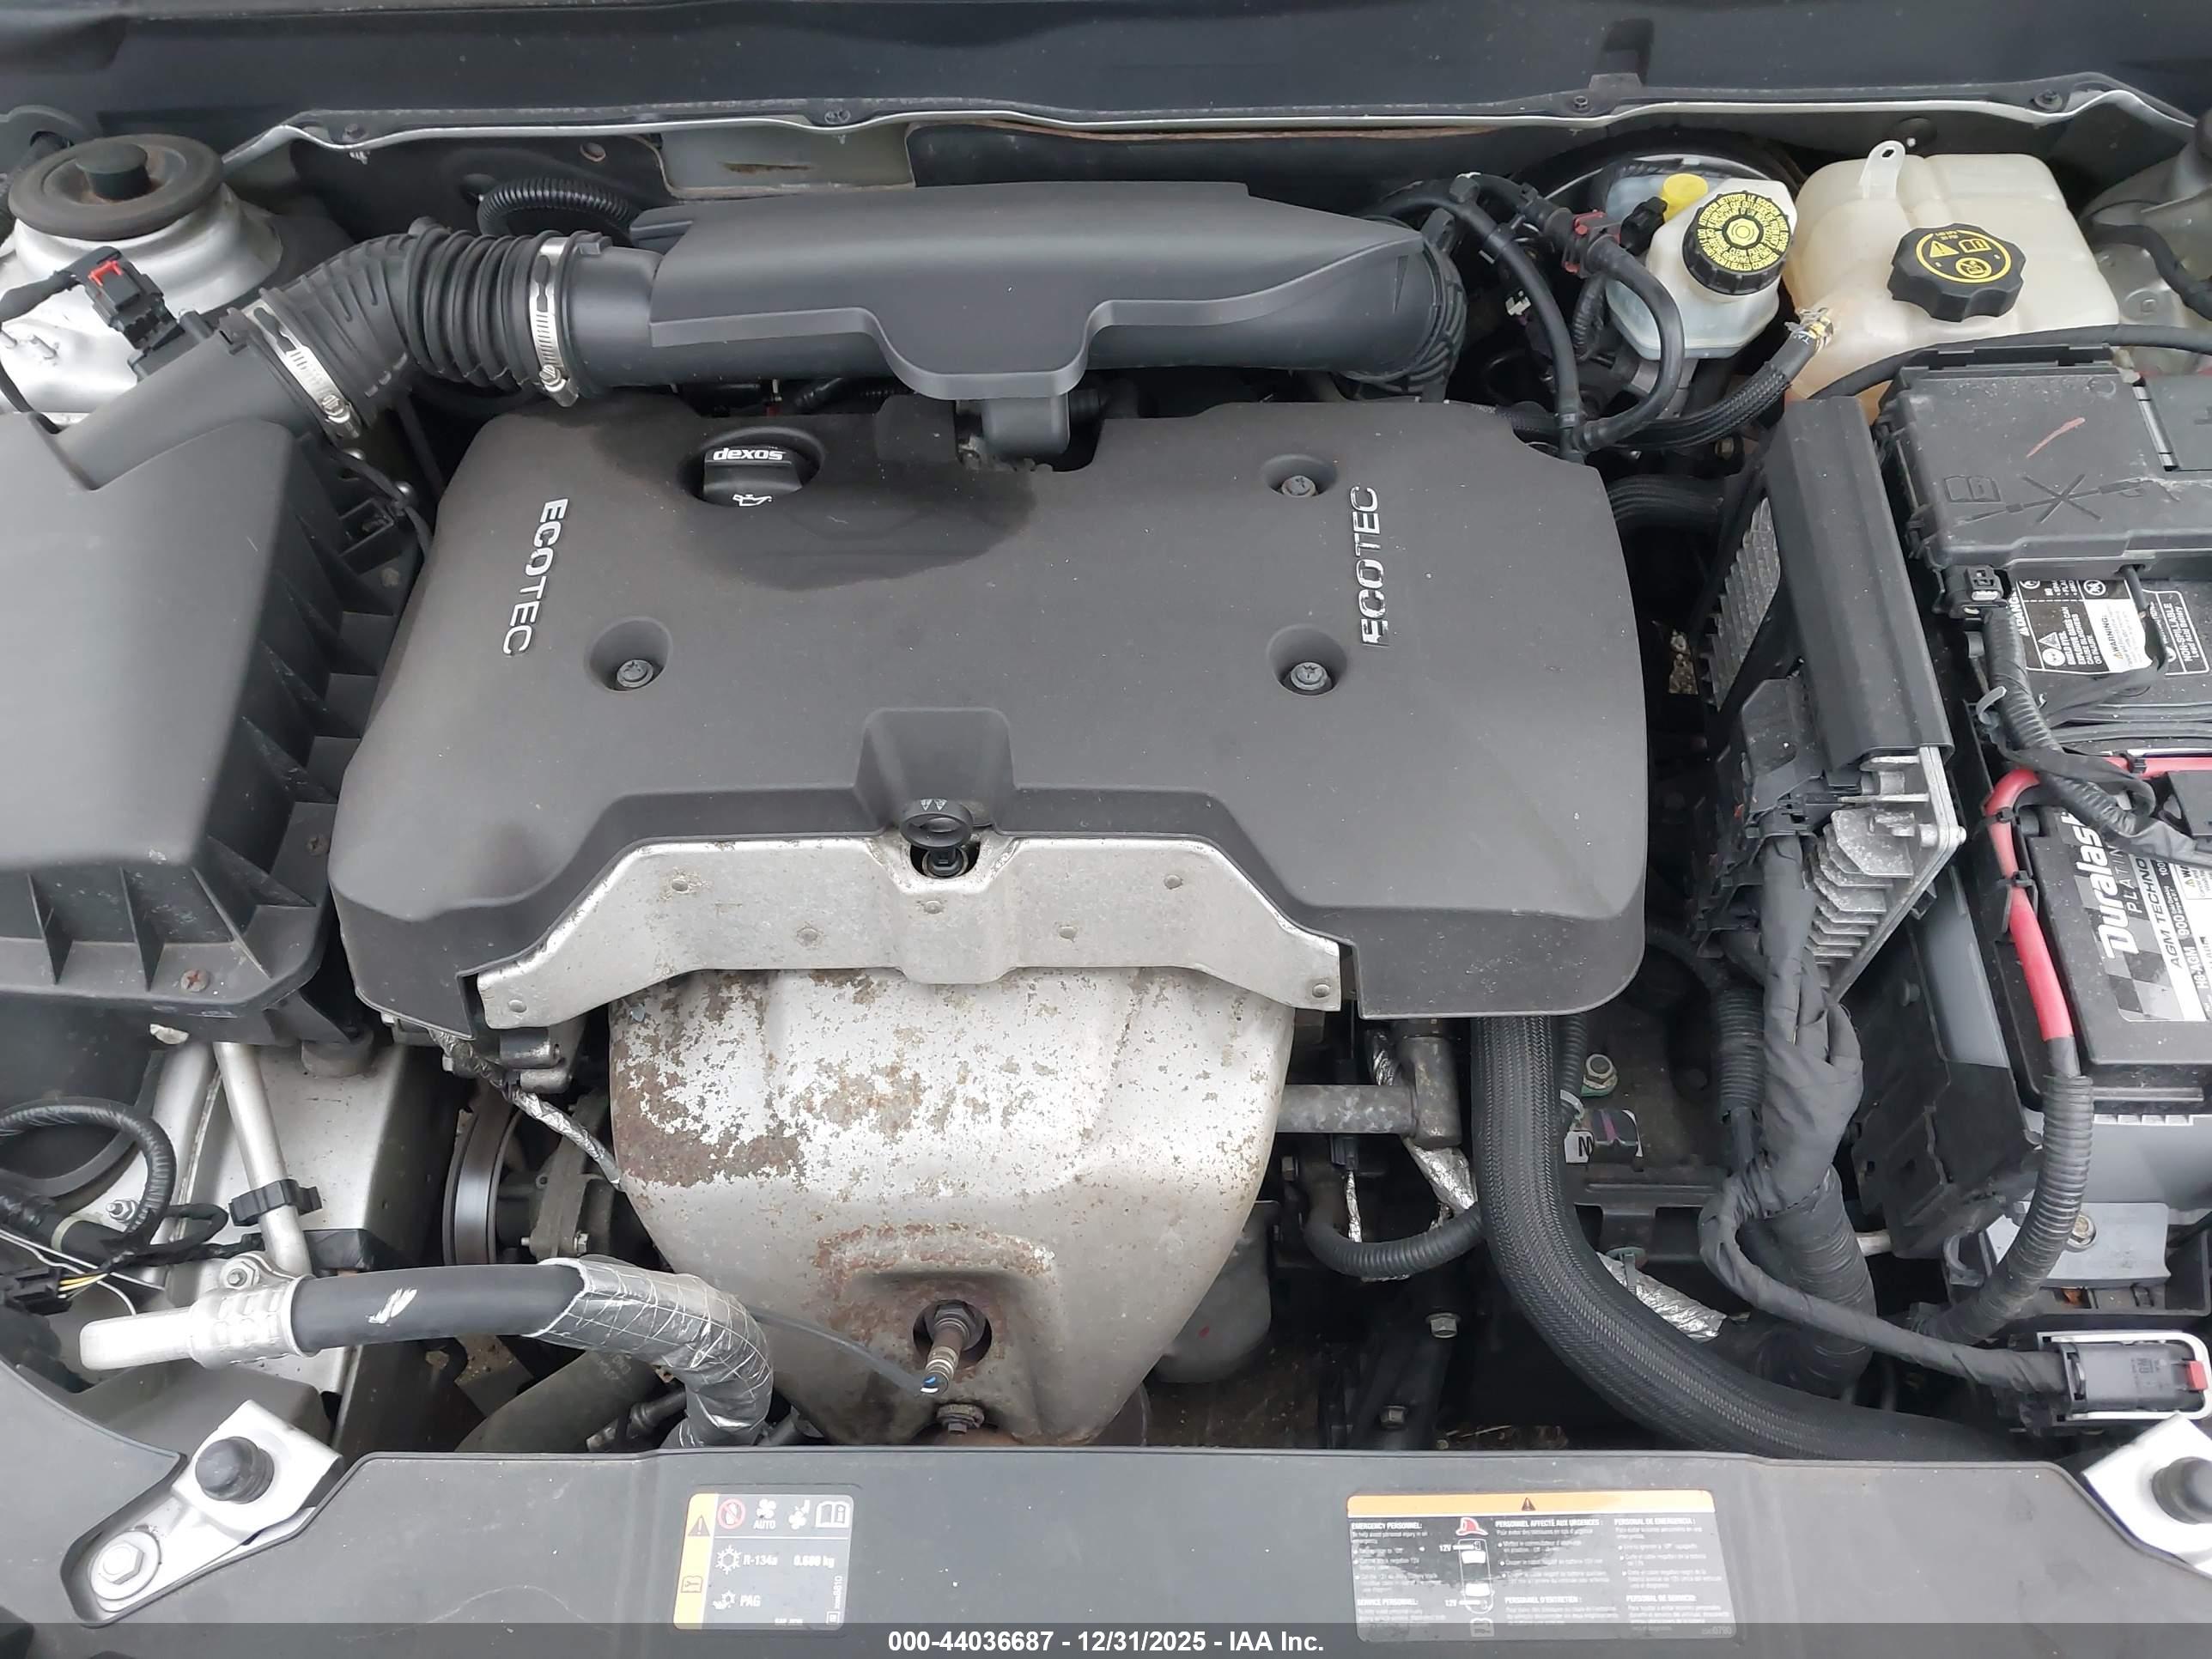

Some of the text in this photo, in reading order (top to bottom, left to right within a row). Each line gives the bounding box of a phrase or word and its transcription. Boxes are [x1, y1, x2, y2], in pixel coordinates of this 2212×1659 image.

[1747, 193, 1755, 202] LE
[714, 447, 787, 461] dexos
[502, 498, 568, 654] ECOTEC
[1350, 486, 1389, 644] ECOTEC
[2072, 614, 2094, 665] CAUSE BLINDNESS
[2163, 603, 2193, 662] NON-SPILLABLE
[2174, 606, 2200, 659] Lead Acid Battery
[2063, 646, 2075, 665] SHIELD
[2069, 636, 2086, 665] EXPLOSIVE
[2173, 915, 2190, 937] 900
[2160, 930, 2182, 969] AGM
[2183, 945, 2209, 989] H8-AGM
[754, 1519, 776, 1529] AUTO
[743, 1554, 778, 1565] R-134a
[823, 1555, 835, 1568] kg
[739, 1595, 761, 1607] PAG
